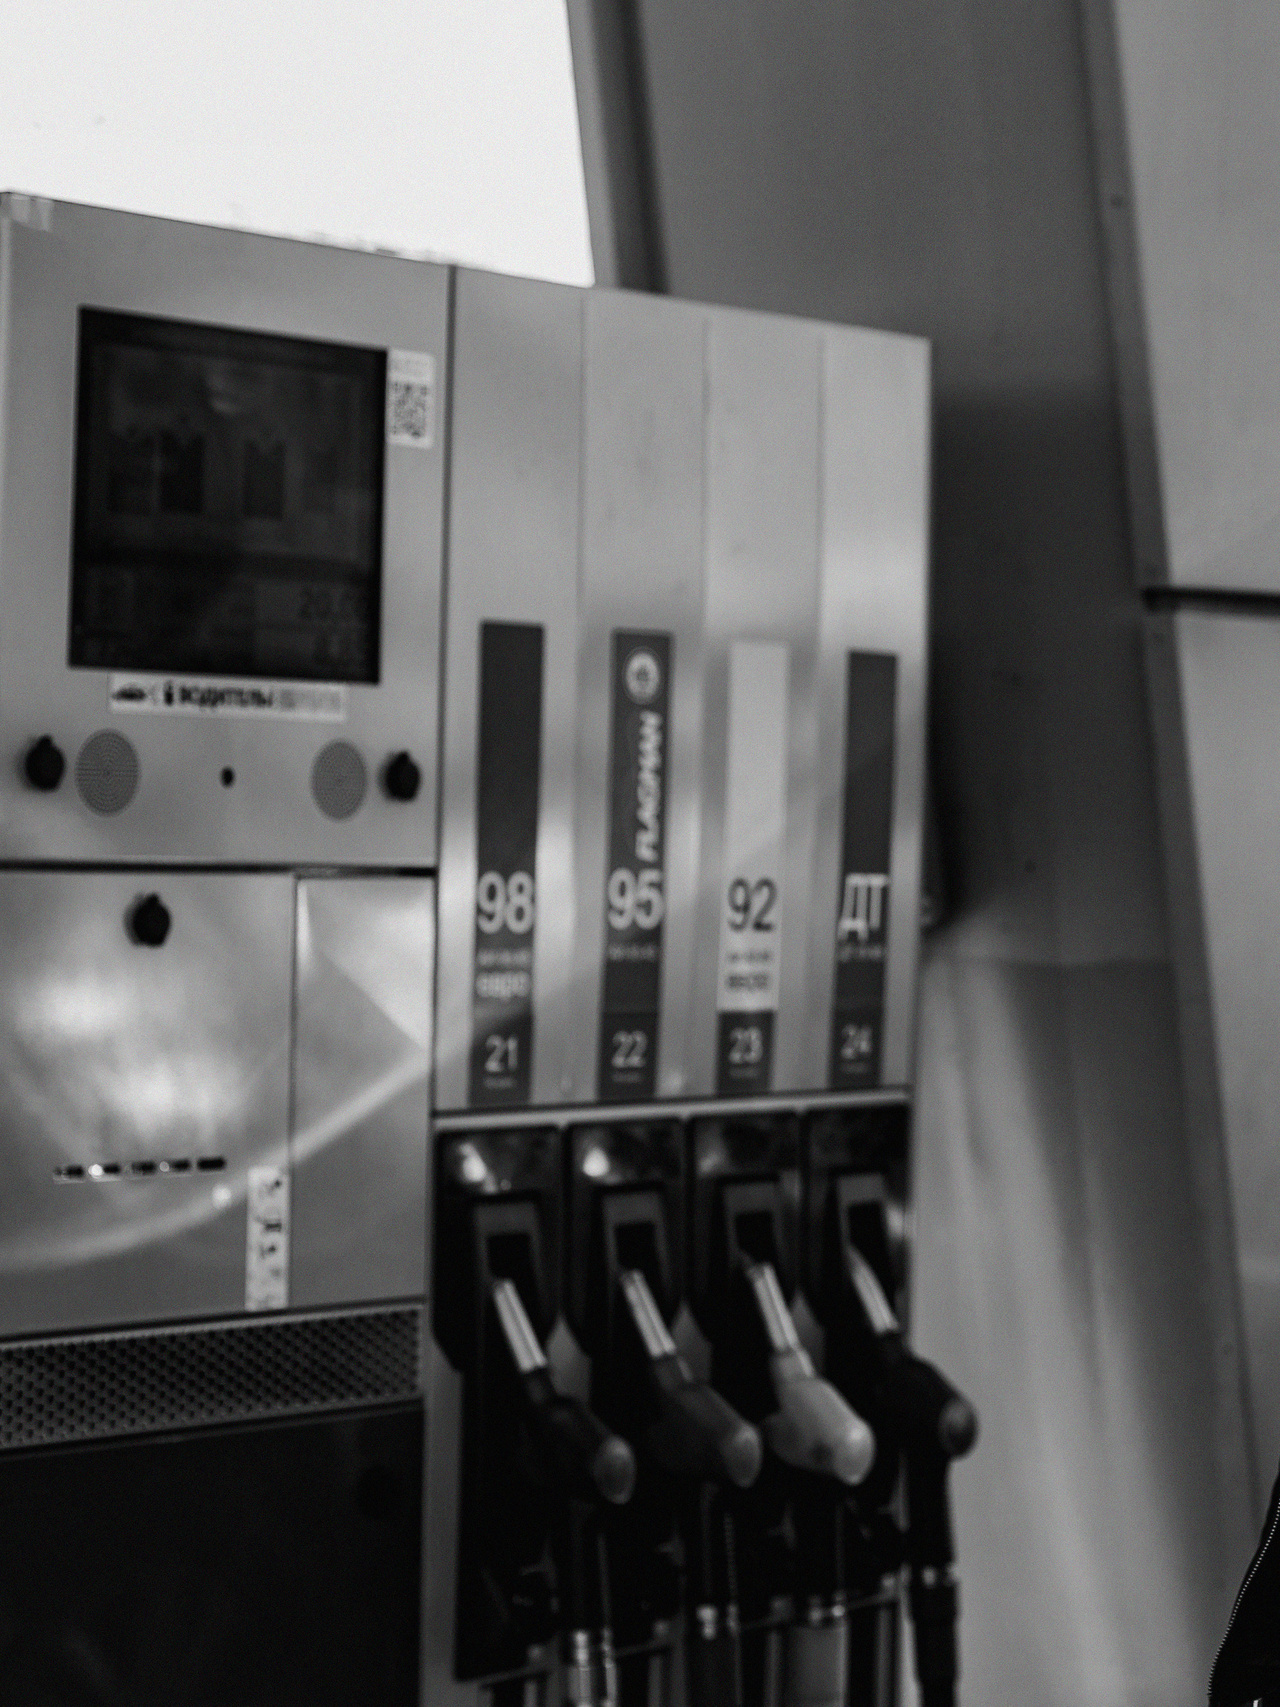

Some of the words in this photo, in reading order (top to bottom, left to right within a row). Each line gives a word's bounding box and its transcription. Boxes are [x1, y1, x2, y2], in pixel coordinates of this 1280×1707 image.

[477, 871, 535, 934] 98
[607, 867, 665, 930] 95
[728, 877, 777, 932] 92
[838, 873, 889, 943] ДТ
[485, 1035, 518, 1073] 21
[611, 1030, 648, 1069] 22
[729, 1027, 763, 1064] 23
[839, 1024, 873, 1060] 24
